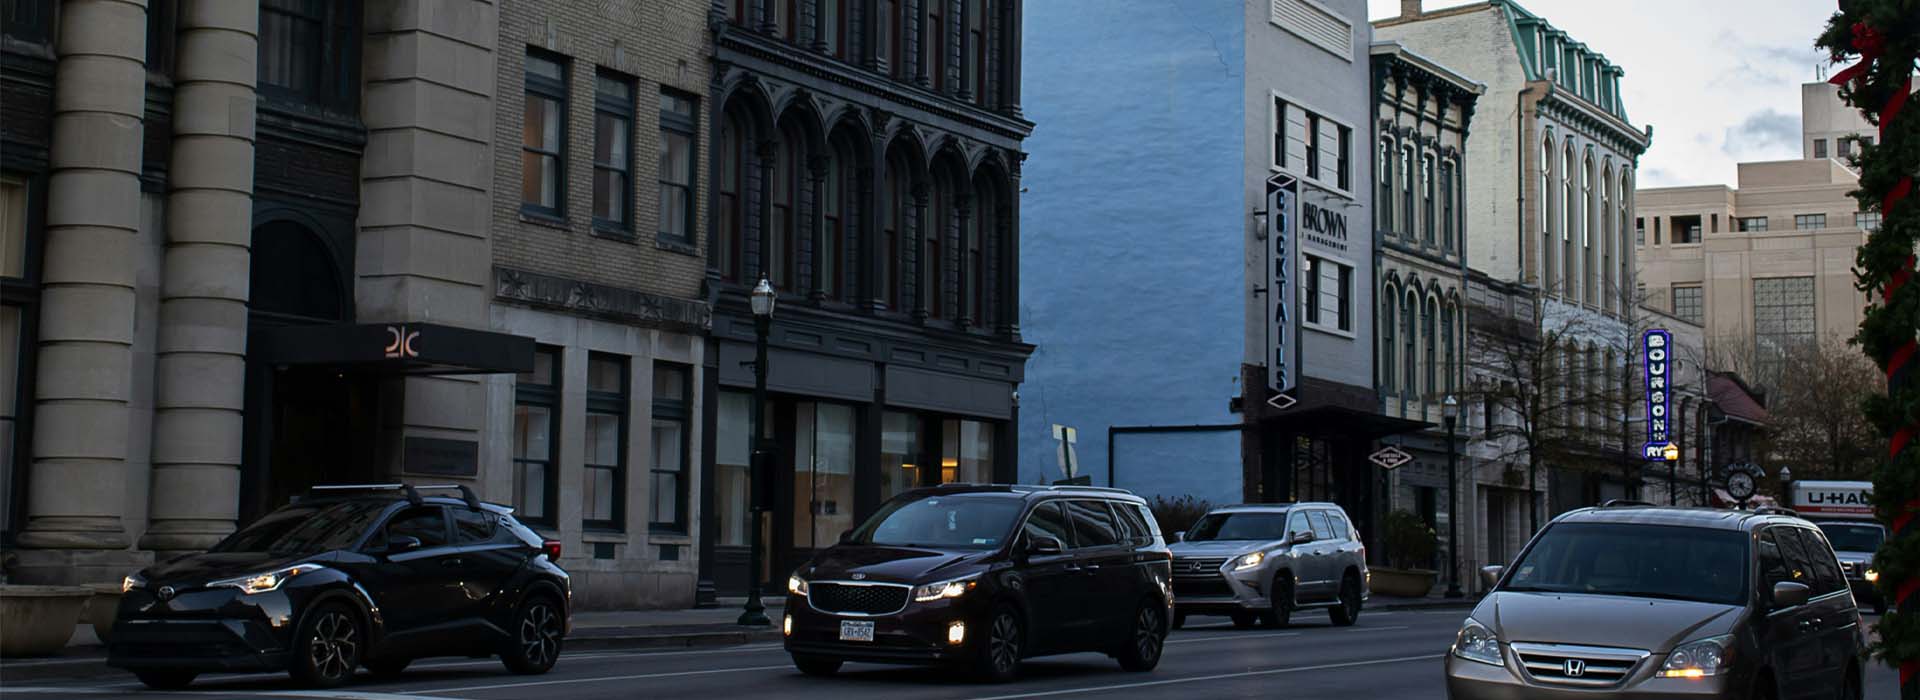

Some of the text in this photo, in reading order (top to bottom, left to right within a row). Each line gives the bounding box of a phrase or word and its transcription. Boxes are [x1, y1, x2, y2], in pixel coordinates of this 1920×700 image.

[1303, 201, 1347, 241] BROWN
[1275, 191, 1288, 390] COCKTAILS
[1648, 335, 1665, 431] BOURBON
[1646, 445, 1664, 458] RY
